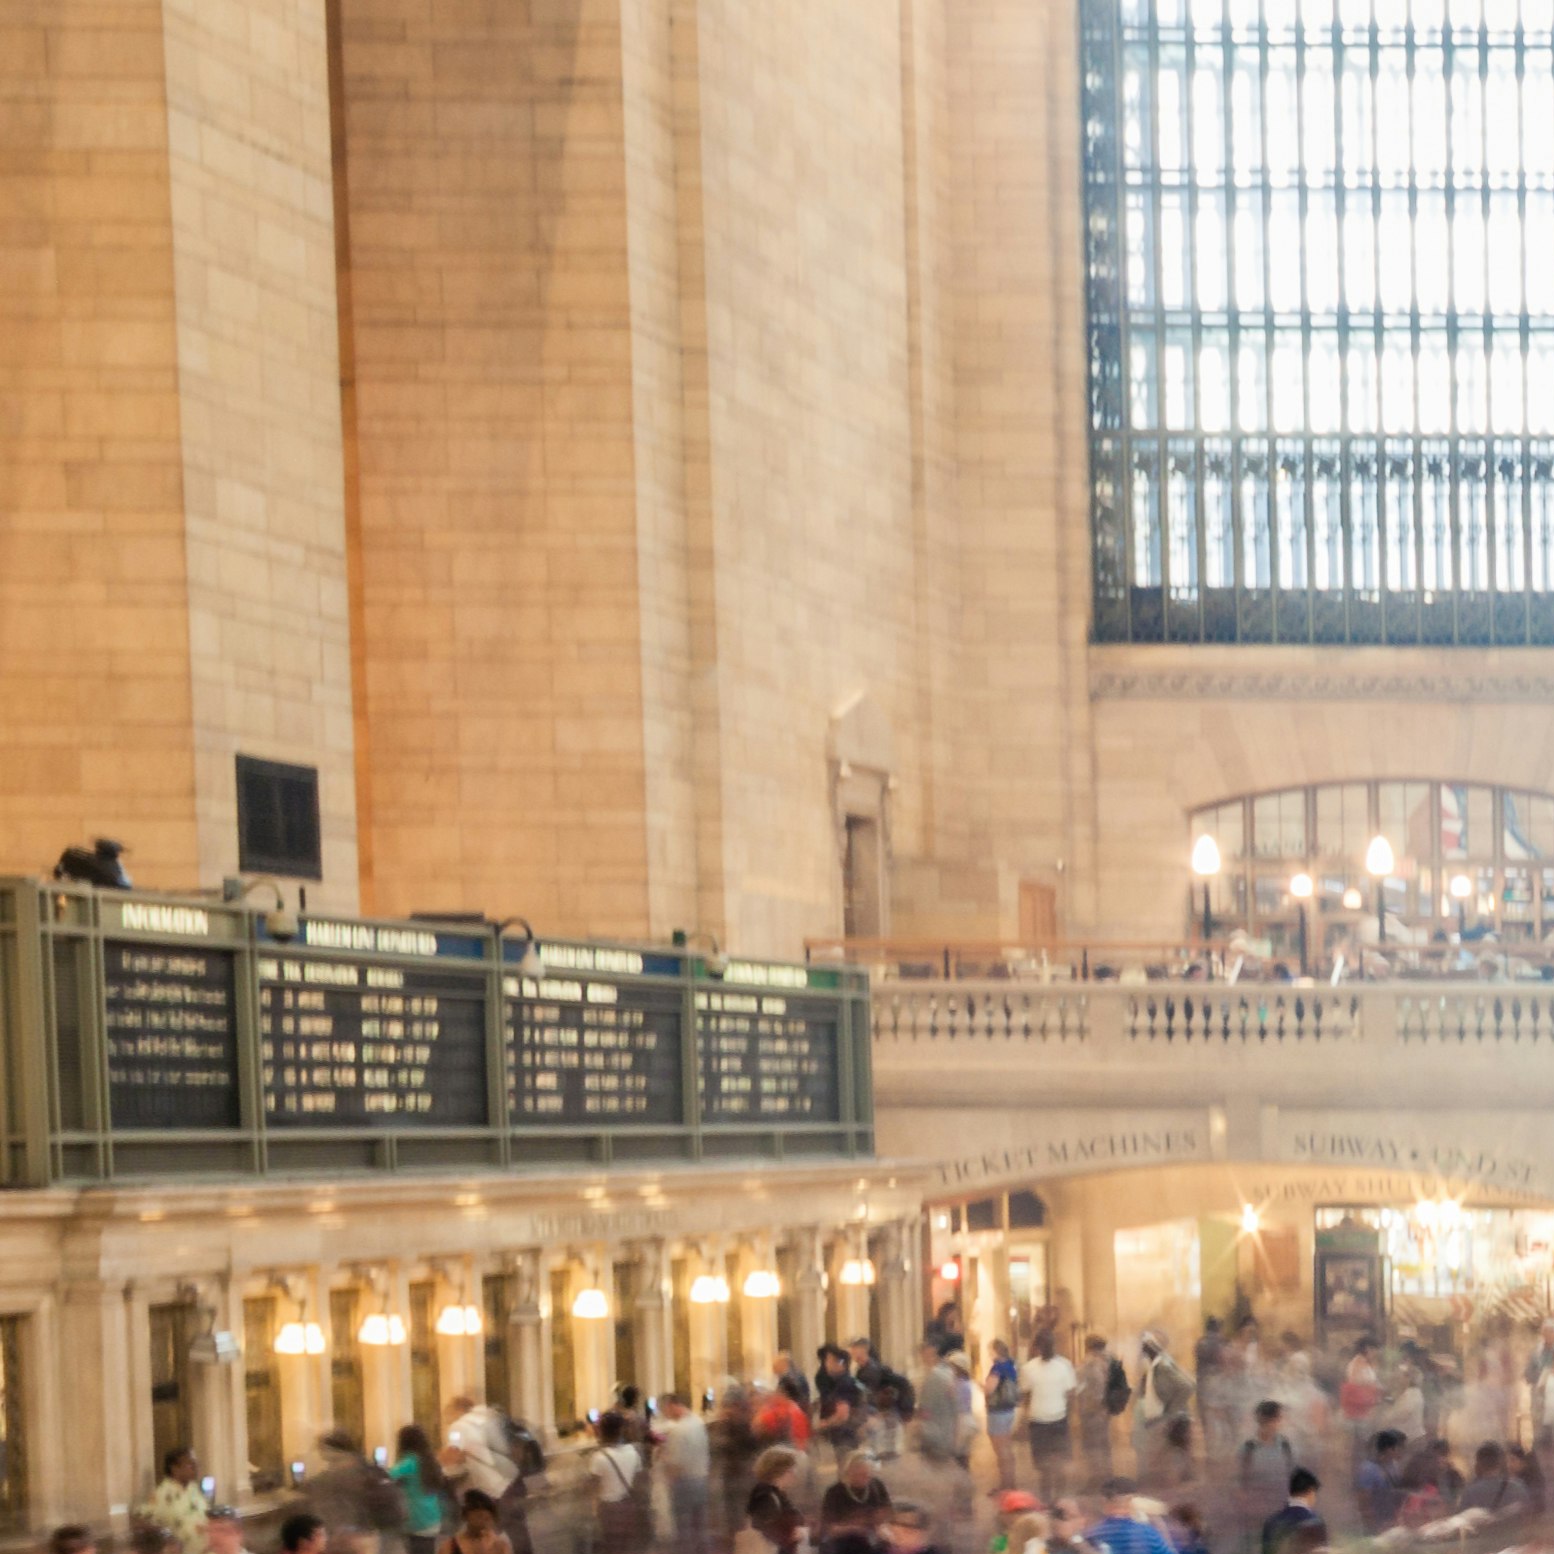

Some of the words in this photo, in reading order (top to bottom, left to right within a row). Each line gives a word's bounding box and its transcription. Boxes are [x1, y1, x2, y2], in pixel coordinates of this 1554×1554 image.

[936, 1148, 1036, 1186] TICKET
[1048, 1131, 1197, 1163] MACHINES
[1294, 1133, 1400, 1162] SUBWAY
